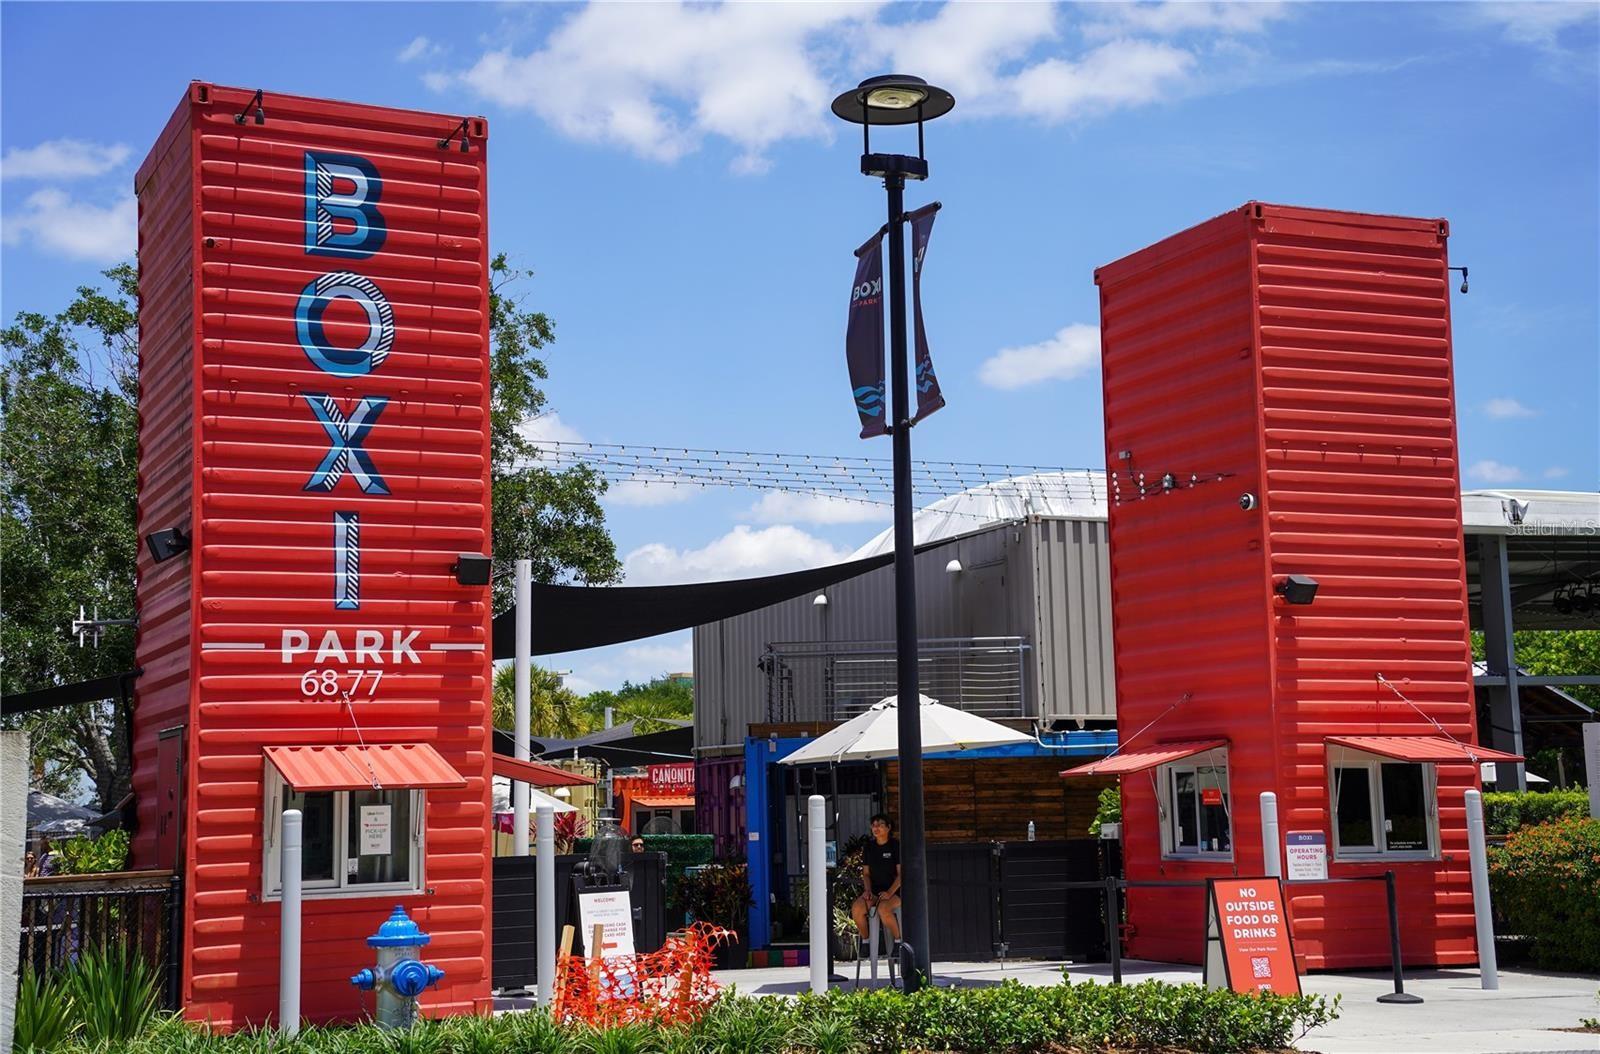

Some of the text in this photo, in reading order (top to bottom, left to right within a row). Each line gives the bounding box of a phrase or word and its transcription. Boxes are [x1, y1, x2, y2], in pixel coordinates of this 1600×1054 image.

[294, 151, 395, 610] BOXI
[281, 629, 422, 664] PARK
[300, 669, 383, 696] 6877
[1240, 888, 1256, 898] NO
[1226, 901, 1275, 912] OUTSIDE
[1226, 914, 1280, 925] FOOD OR
[1234, 928, 1277, 939] DRINKS
